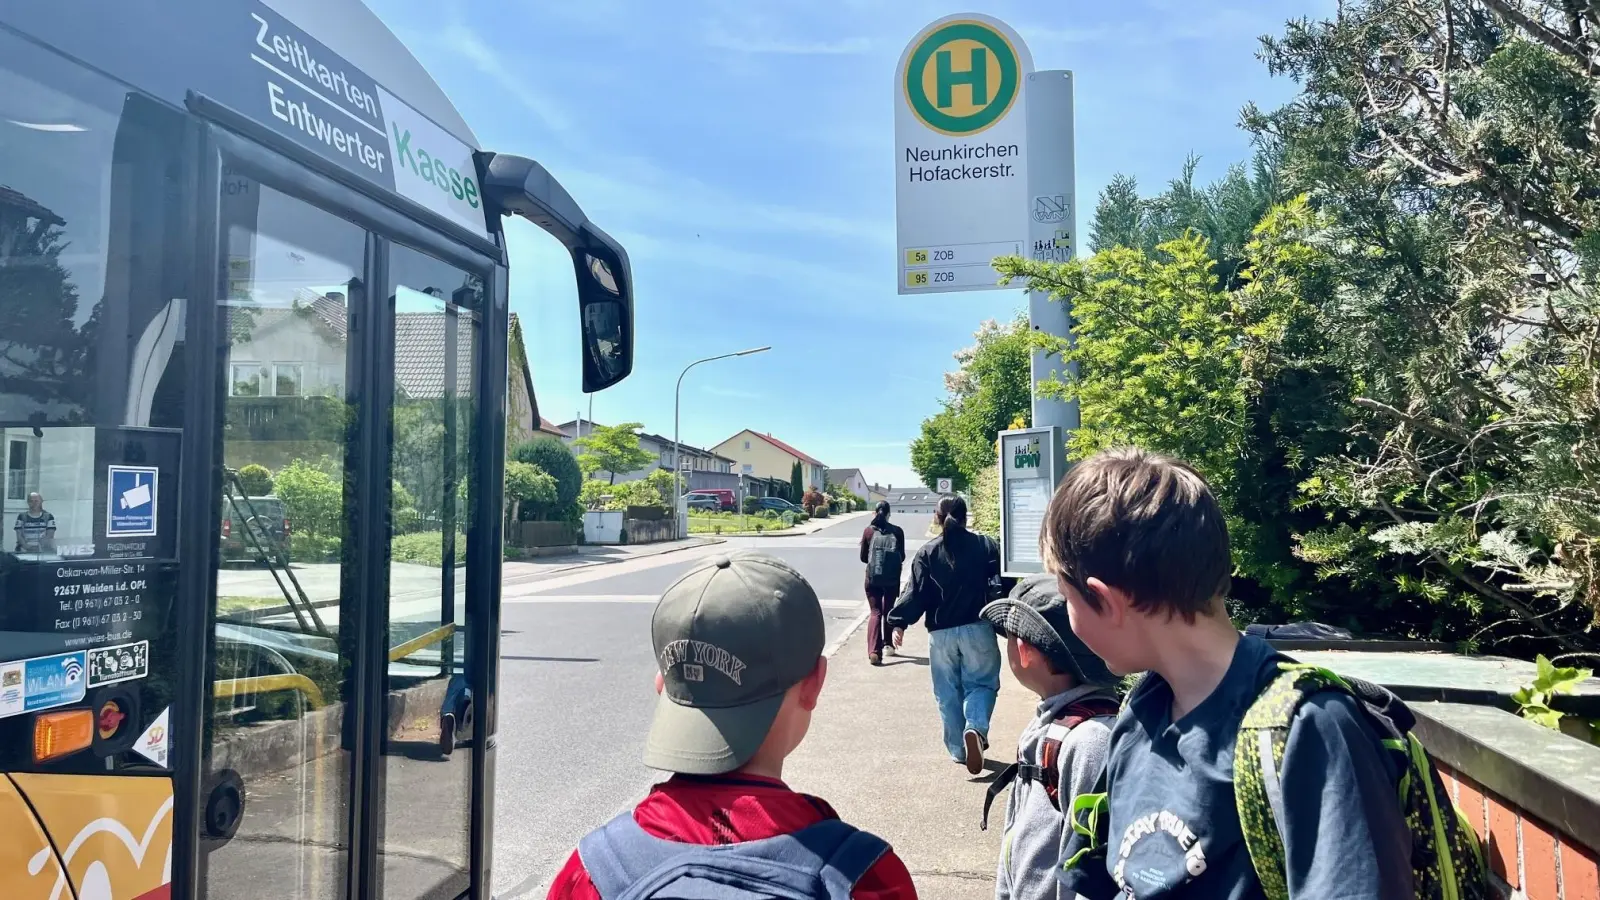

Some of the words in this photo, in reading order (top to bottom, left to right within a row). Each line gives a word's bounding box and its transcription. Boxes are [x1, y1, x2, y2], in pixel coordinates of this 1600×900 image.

[251, 12, 378, 118] Zeitkarten
[936, 47, 988, 109] H
[268, 82, 385, 173] Entwerter
[906, 143, 1018, 162] Neunkirchen
[392, 121, 479, 209] Kasse
[910, 163, 1015, 182] Hofackerstr.
[915, 252, 926, 262] 5a
[934, 250, 954, 261] ZOB
[915, 274, 927, 283] 95
[934, 272, 955, 282] ZOB
[137, 564, 145, 573] 14
[54, 585, 80, 596] 92637
[82, 583, 114, 594] Weiden
[115, 581, 129, 592] i.d.
[130, 580, 147, 590] OPf.
[59, 600, 73, 611] Tel.
[55, 618, 70, 629] Fax
[64, 630, 133, 647] www.wies-bus.de
[660, 639, 689, 675] NEW
[690, 640, 747, 686] YORK
[27, 672, 63, 693] WLAN
[1119, 812, 1160, 858] STAY
